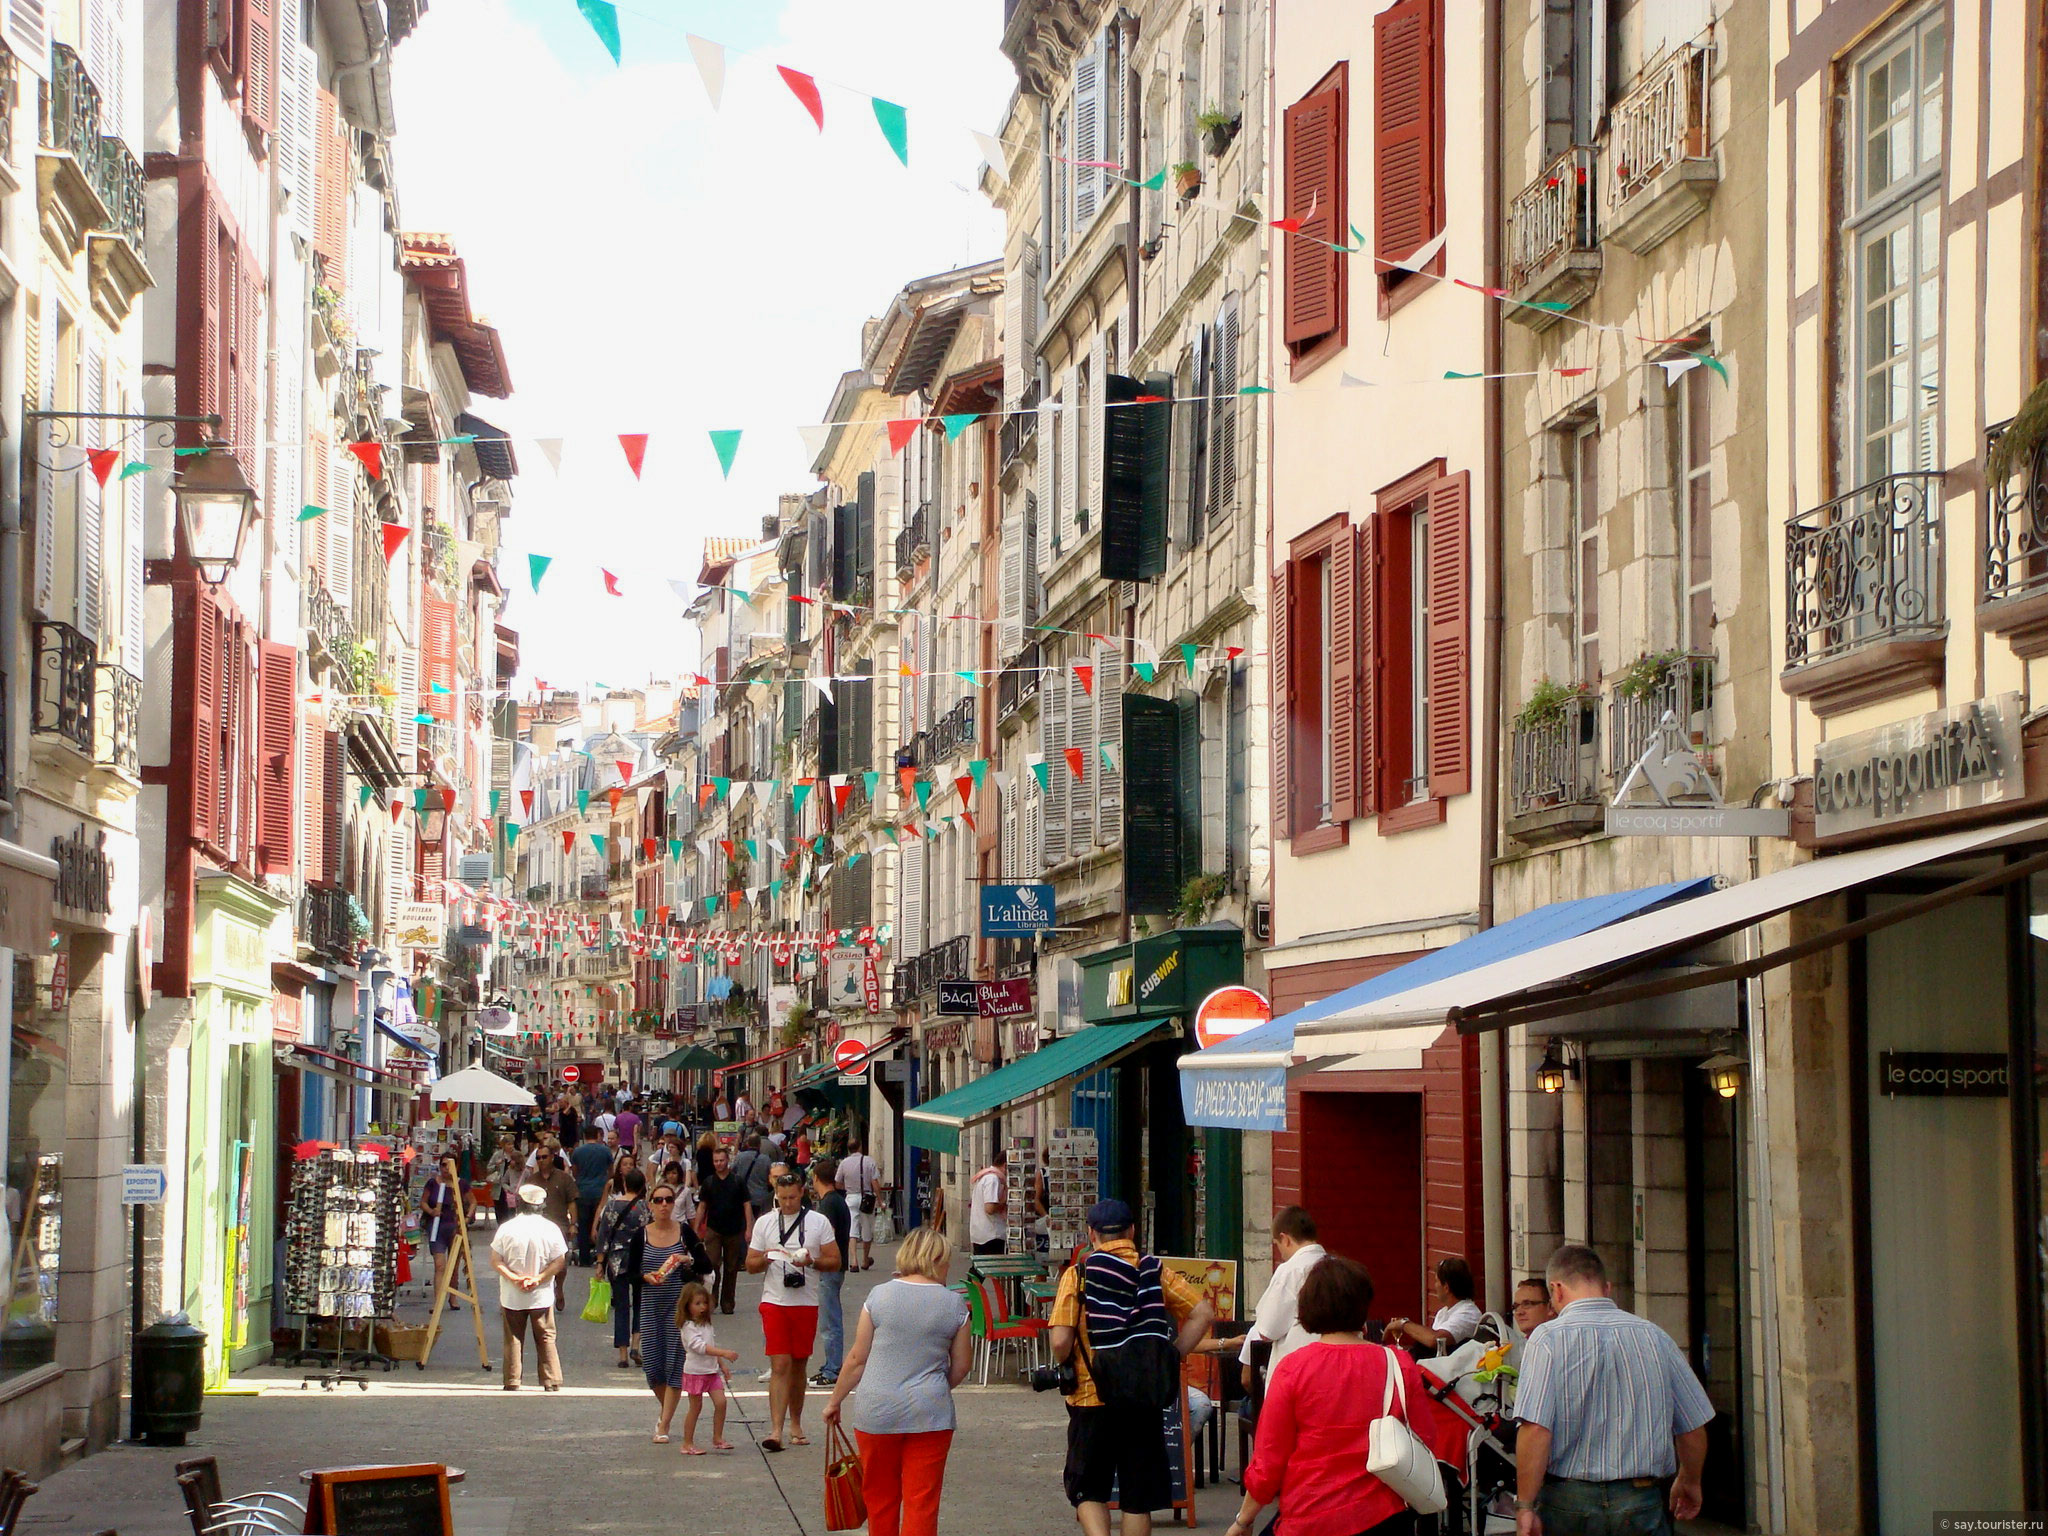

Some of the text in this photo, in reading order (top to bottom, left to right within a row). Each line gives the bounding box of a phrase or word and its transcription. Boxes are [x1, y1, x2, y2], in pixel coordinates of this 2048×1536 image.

[1832, 758, 1880, 818] coq
[1878, 722, 1960, 814] sportif
[1615, 813, 1725, 832] le coq sportif
[832, 952, 863, 960] Casino
[865, 959, 878, 1012] TABAC
[1140, 950, 1179, 999] SUBWAY
[979, 985, 1010, 1000] Blush
[982, 999, 1024, 1016] Noisette
[1888, 1064, 1905, 1083] le
[1909, 1069, 1948, 1088] coq
[1194, 1081, 1204, 1117] LA
[1227, 1081, 1238, 1117] DE
